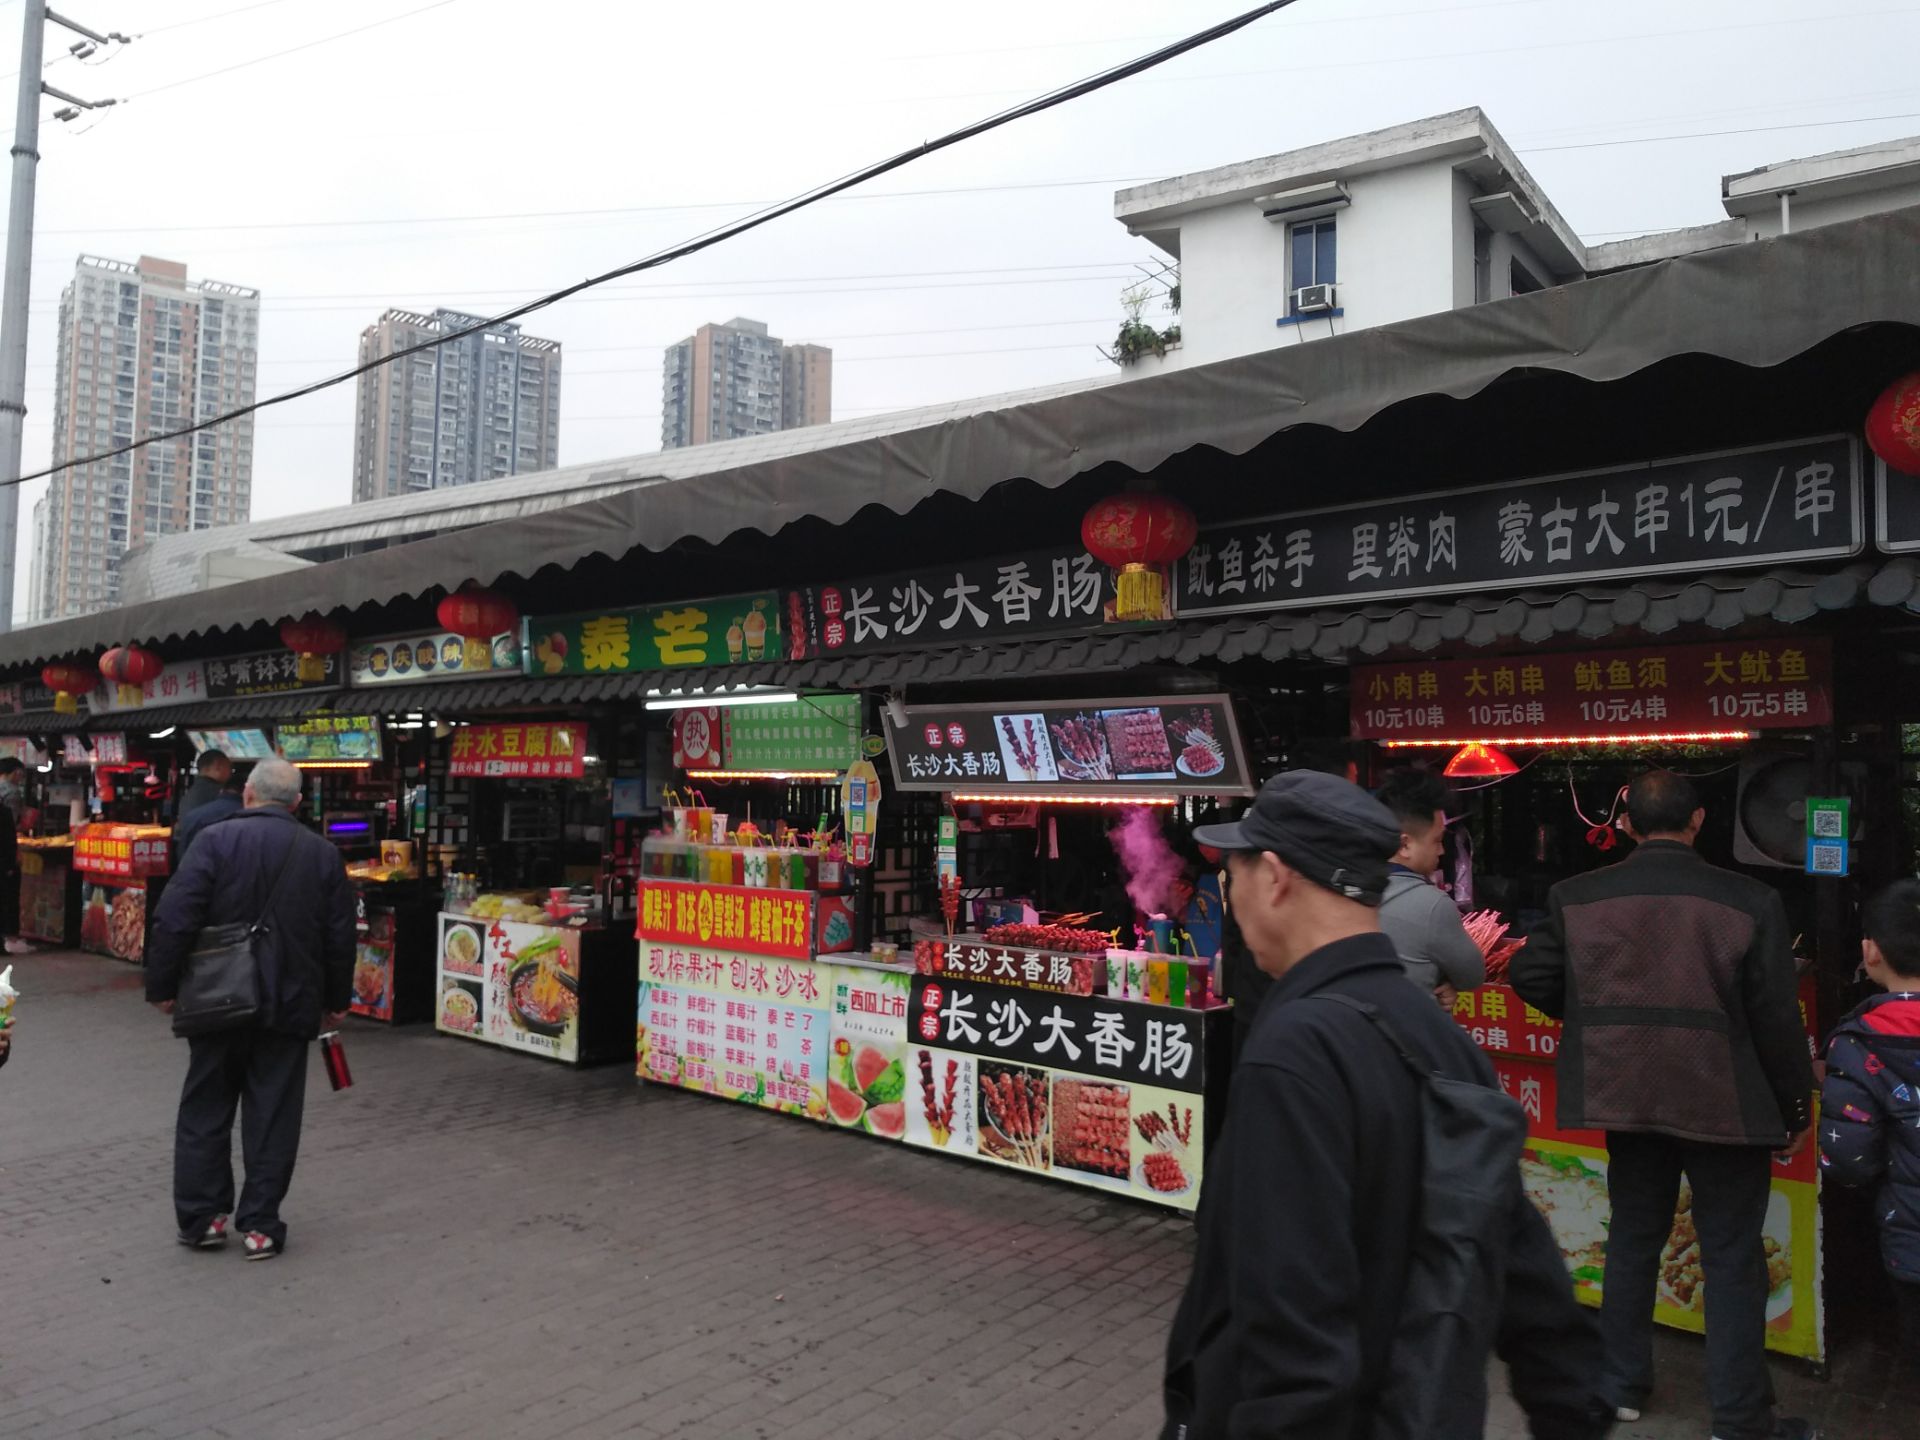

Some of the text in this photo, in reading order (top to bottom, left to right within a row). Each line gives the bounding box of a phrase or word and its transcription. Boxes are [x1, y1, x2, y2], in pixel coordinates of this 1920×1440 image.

[1187, 528, 1315, 597] 鱿鱼杀手
[1347, 511, 1457, 582] 里脊肉
[825, 594, 843, 645] 正宗
[844, 552, 1101, 643] 长沙大香肠
[580, 607, 709, 671] 泰芒
[1368, 648, 1809, 702] 小肉串 大肉串 鱿鱼须 大鱿鱼
[687, 715, 707, 751] 热
[1365, 688, 1809, 729] 10元10串 10元6串 10元4串 10元5串
[452, 725, 577, 758] 井水豆腐脑
[927, 725, 965, 746] 正宗
[906, 750, 1001, 779] 长沙大香肠
[749, 895, 805, 948] 蜂蜜柚子茶
[649, 947, 819, 1001] 现榨果汁 刨冰 沙冰
[944, 942, 1073, 985] 长沙大香肠
[851, 989, 906, 1018] 西瓜上市
[922, 988, 940, 1037] 正宗
[939, 989, 1194, 1080] 长沙大香肠
[725, 1070, 757, 1092] 双皮奶
